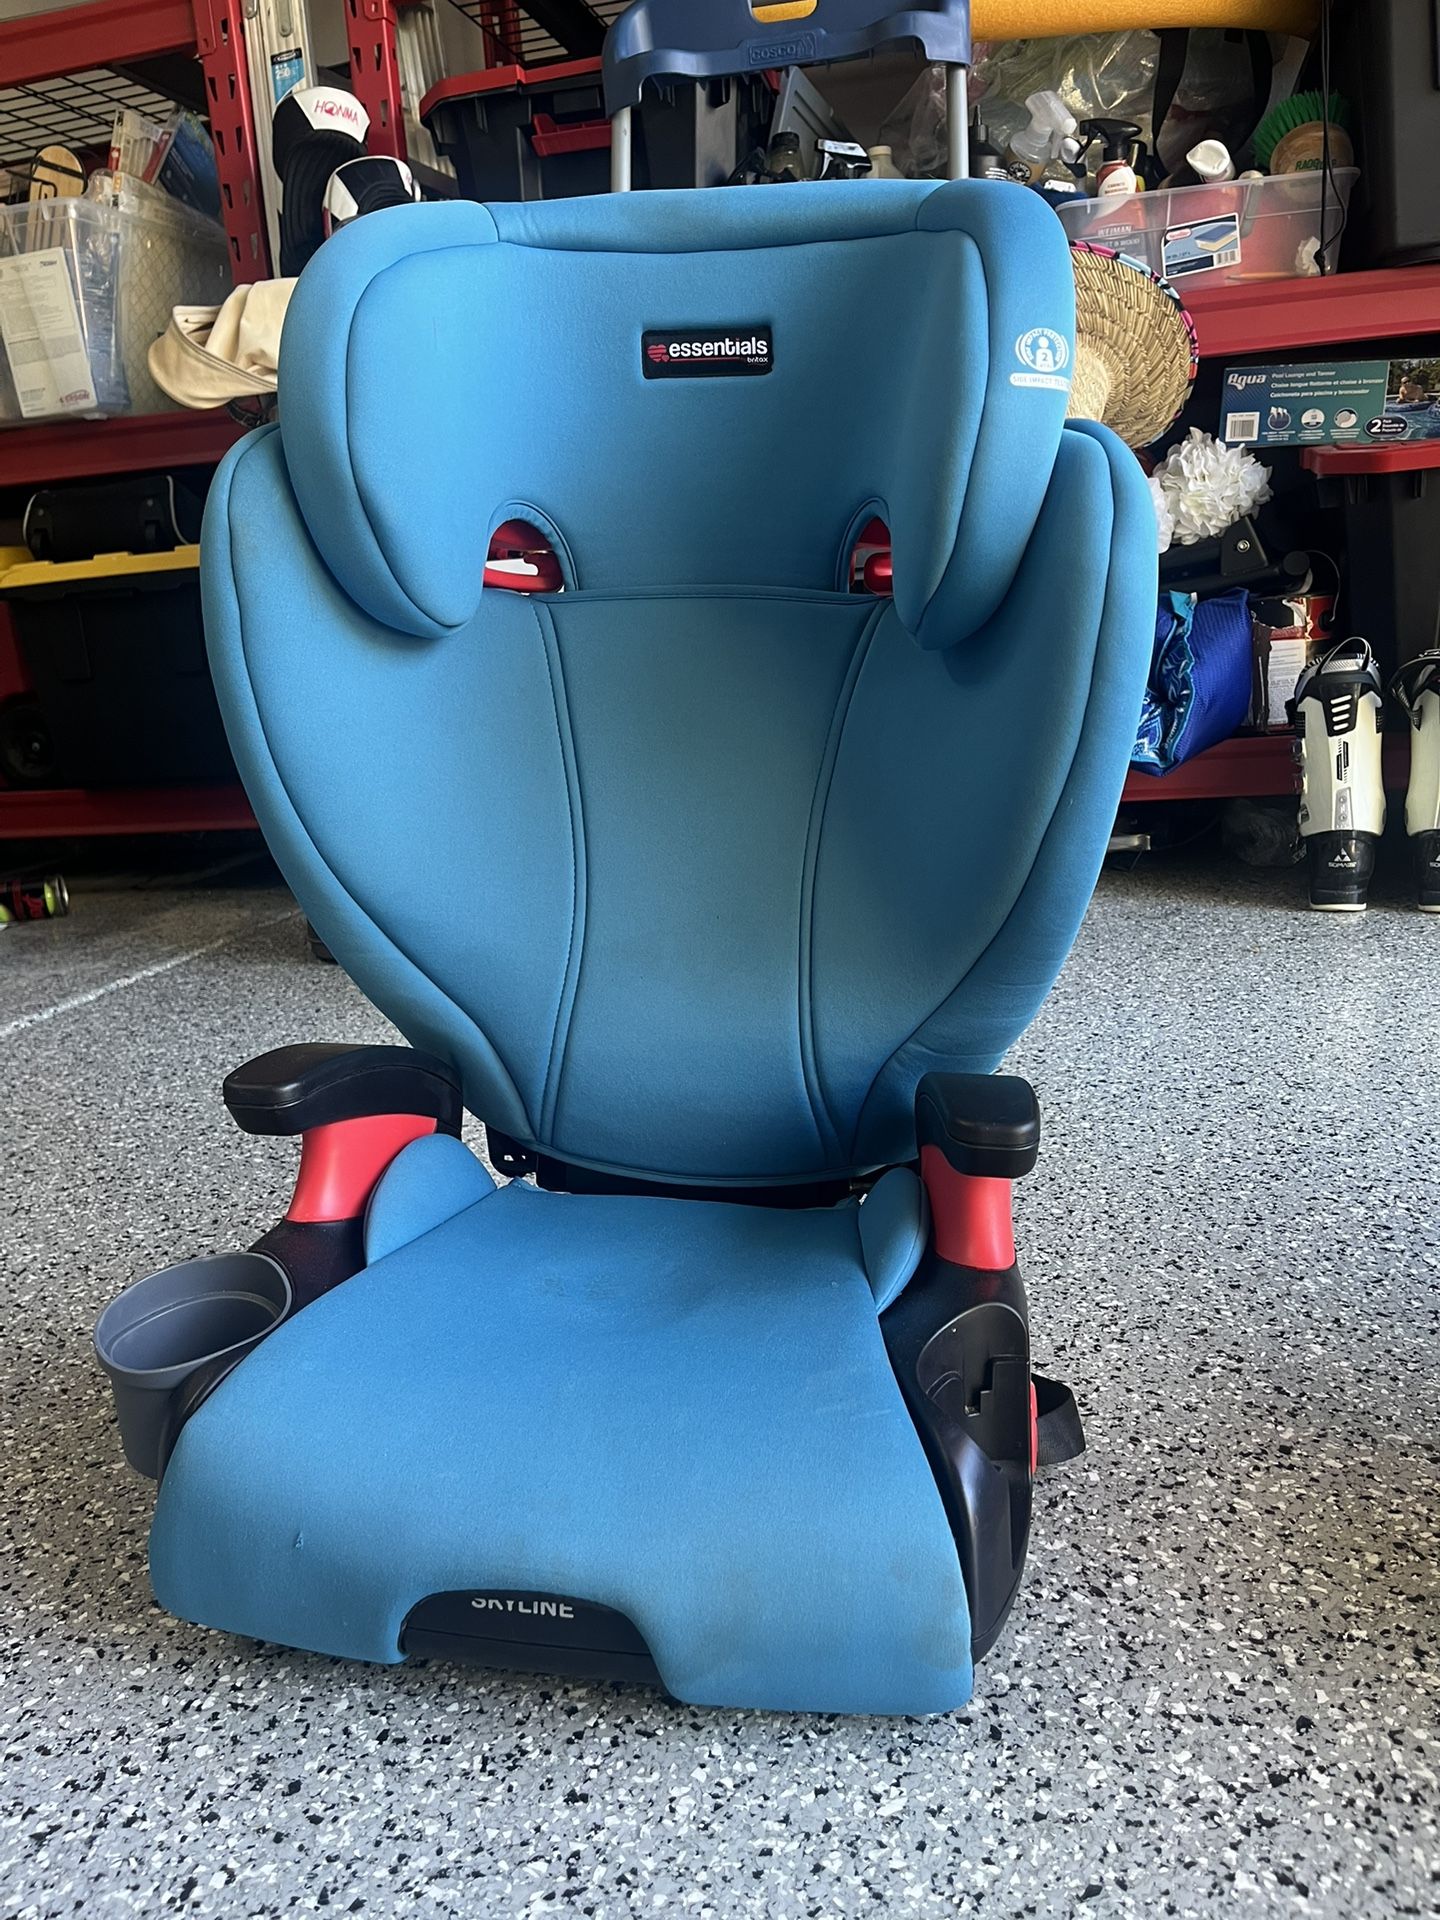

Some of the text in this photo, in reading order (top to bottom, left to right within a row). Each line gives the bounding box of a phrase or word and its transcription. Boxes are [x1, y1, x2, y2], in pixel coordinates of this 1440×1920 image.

[752, 44, 796, 59] COSCO
[314, 99, 359, 126] HONMA
[668, 336, 768, 358] essentials
[746, 356, 769, 364] britax
[1227, 373, 1267, 390] Aqua
[1370, 419, 1382, 433] 2
[471, 1597, 574, 1619] SKYLINE
